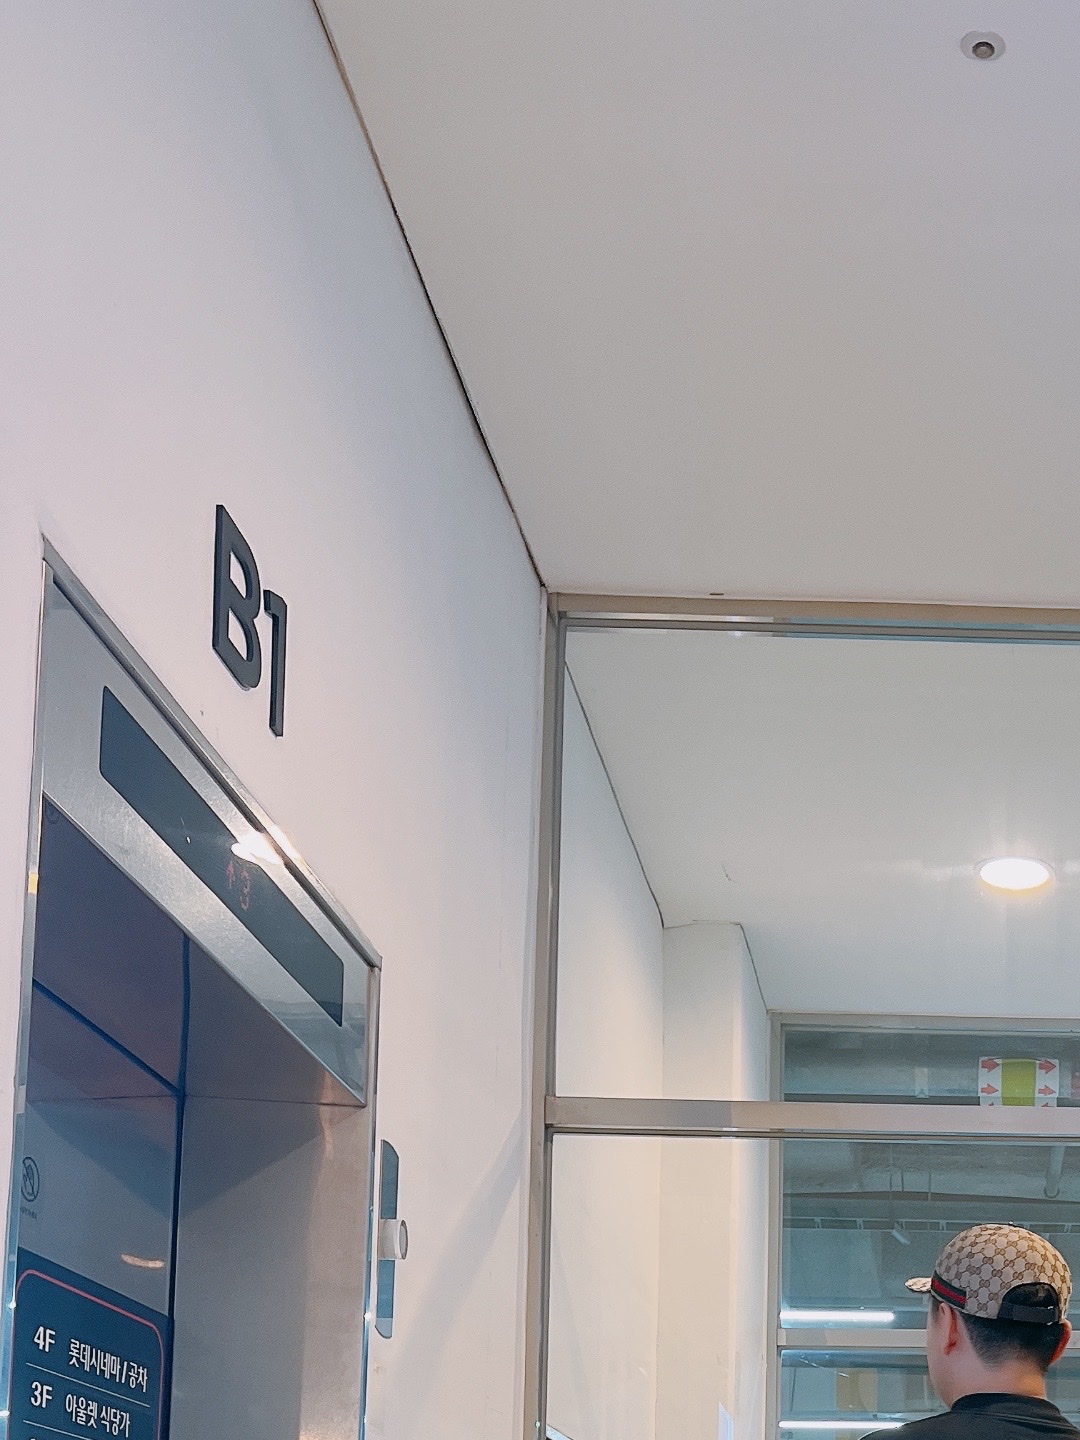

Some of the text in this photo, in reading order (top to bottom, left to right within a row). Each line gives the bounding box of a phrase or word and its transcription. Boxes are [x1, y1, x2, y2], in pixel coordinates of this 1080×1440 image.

[212, 504, 287, 737] B1
[34, 1325, 55, 1353] 4F
[69, 1338, 121, 1383] 롯데시네마
[128, 1361, 148, 1392] 공차
[31, 1382, 130, 1438] 3F 아울렛 식당가
